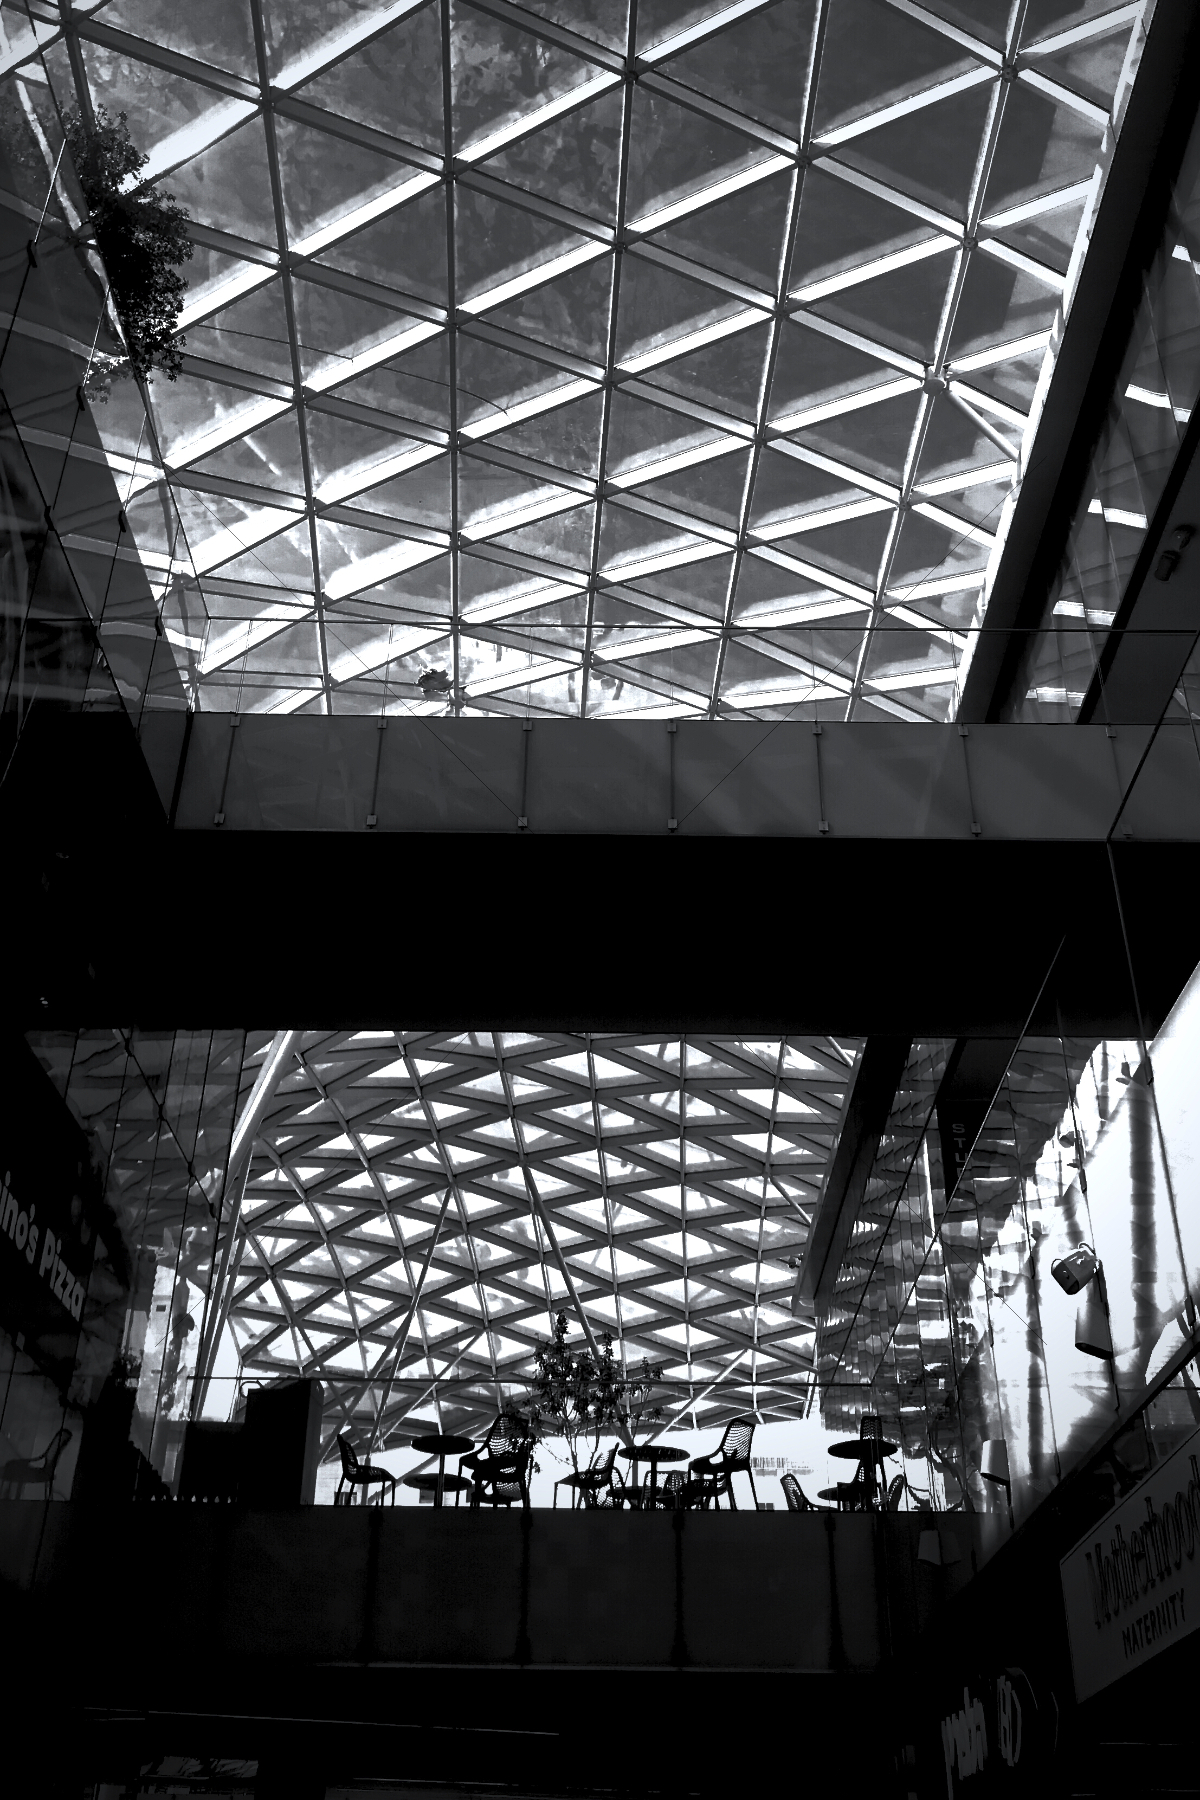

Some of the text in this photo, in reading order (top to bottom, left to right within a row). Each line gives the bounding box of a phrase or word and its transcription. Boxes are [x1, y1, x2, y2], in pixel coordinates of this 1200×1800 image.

[0, 1170, 86, 1323] ino's Pizza
[1122, 1587, 1187, 1659] MATERNITY
